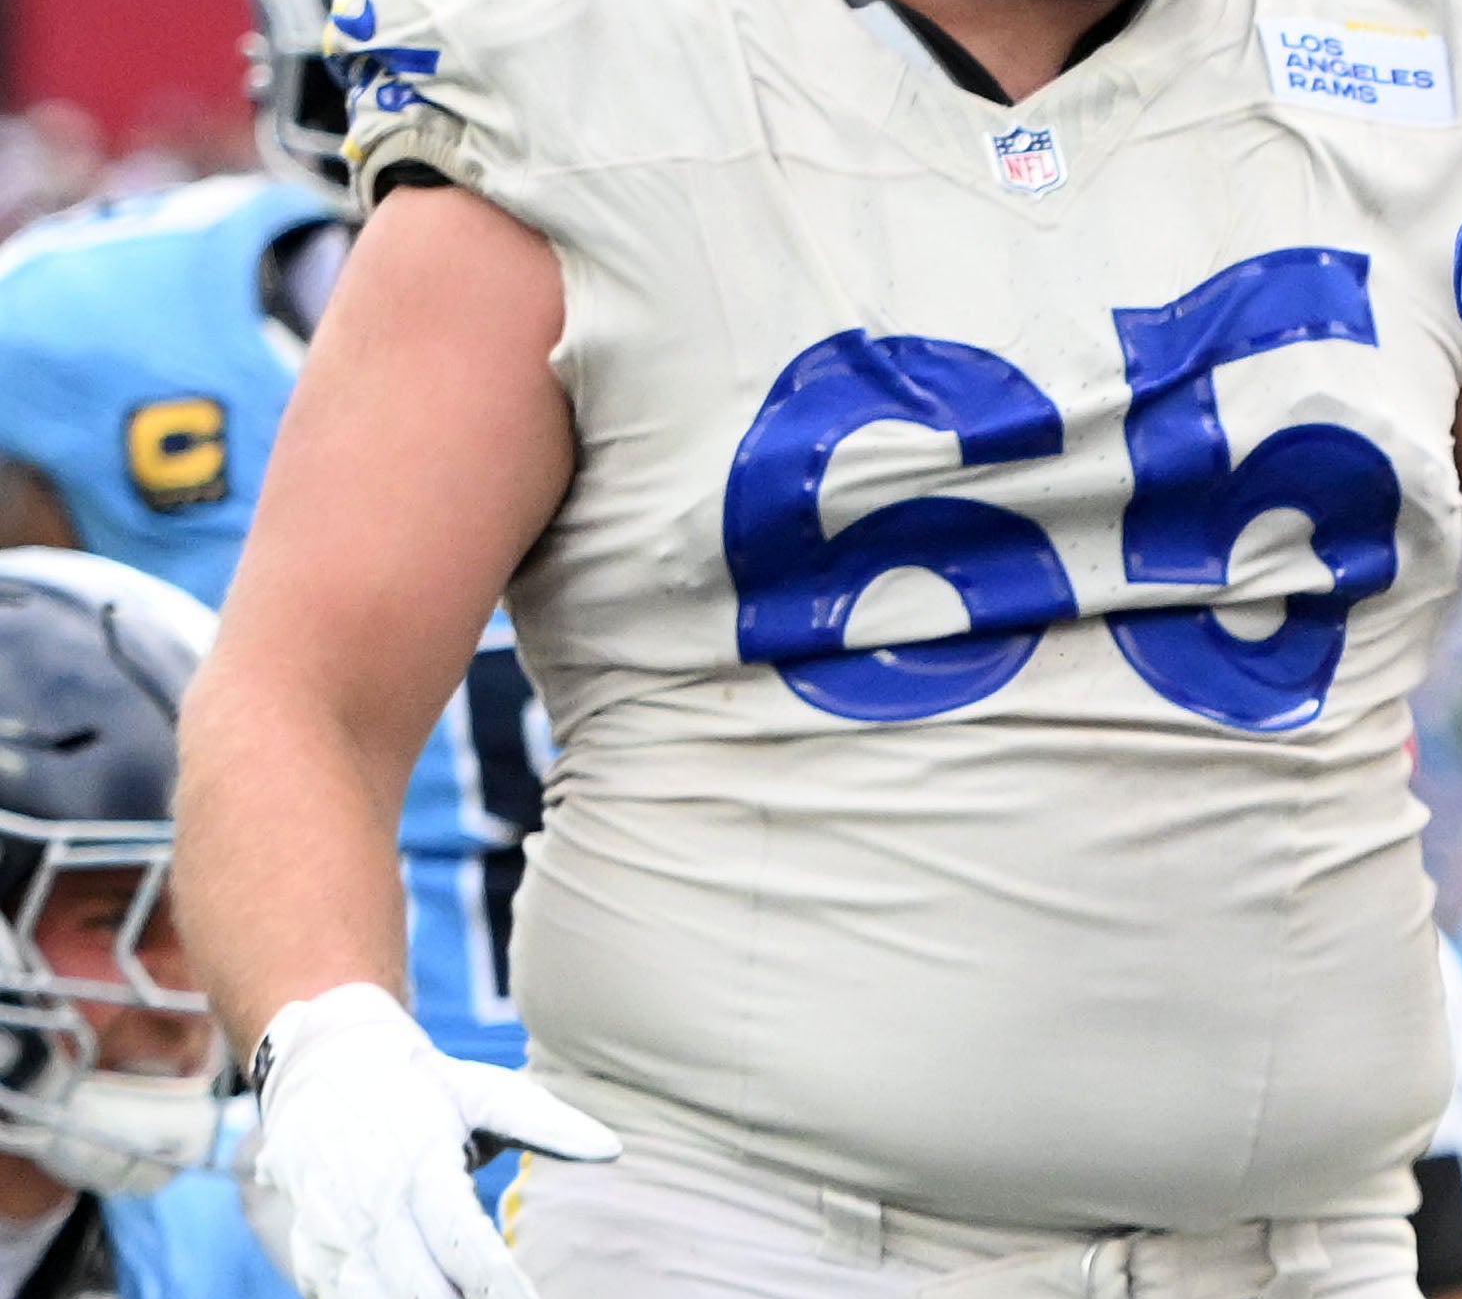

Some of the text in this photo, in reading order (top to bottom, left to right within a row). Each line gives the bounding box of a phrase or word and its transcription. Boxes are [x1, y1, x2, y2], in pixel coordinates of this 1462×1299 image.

[1280, 31, 1344, 57] LOS
[1286, 51, 1435, 89] ANGELES
[1288, 71, 1378, 105] RAMS
[1003, 153, 1057, 184] NFL
[129, 398, 226, 492] C
[722, 244, 1403, 733] 65
